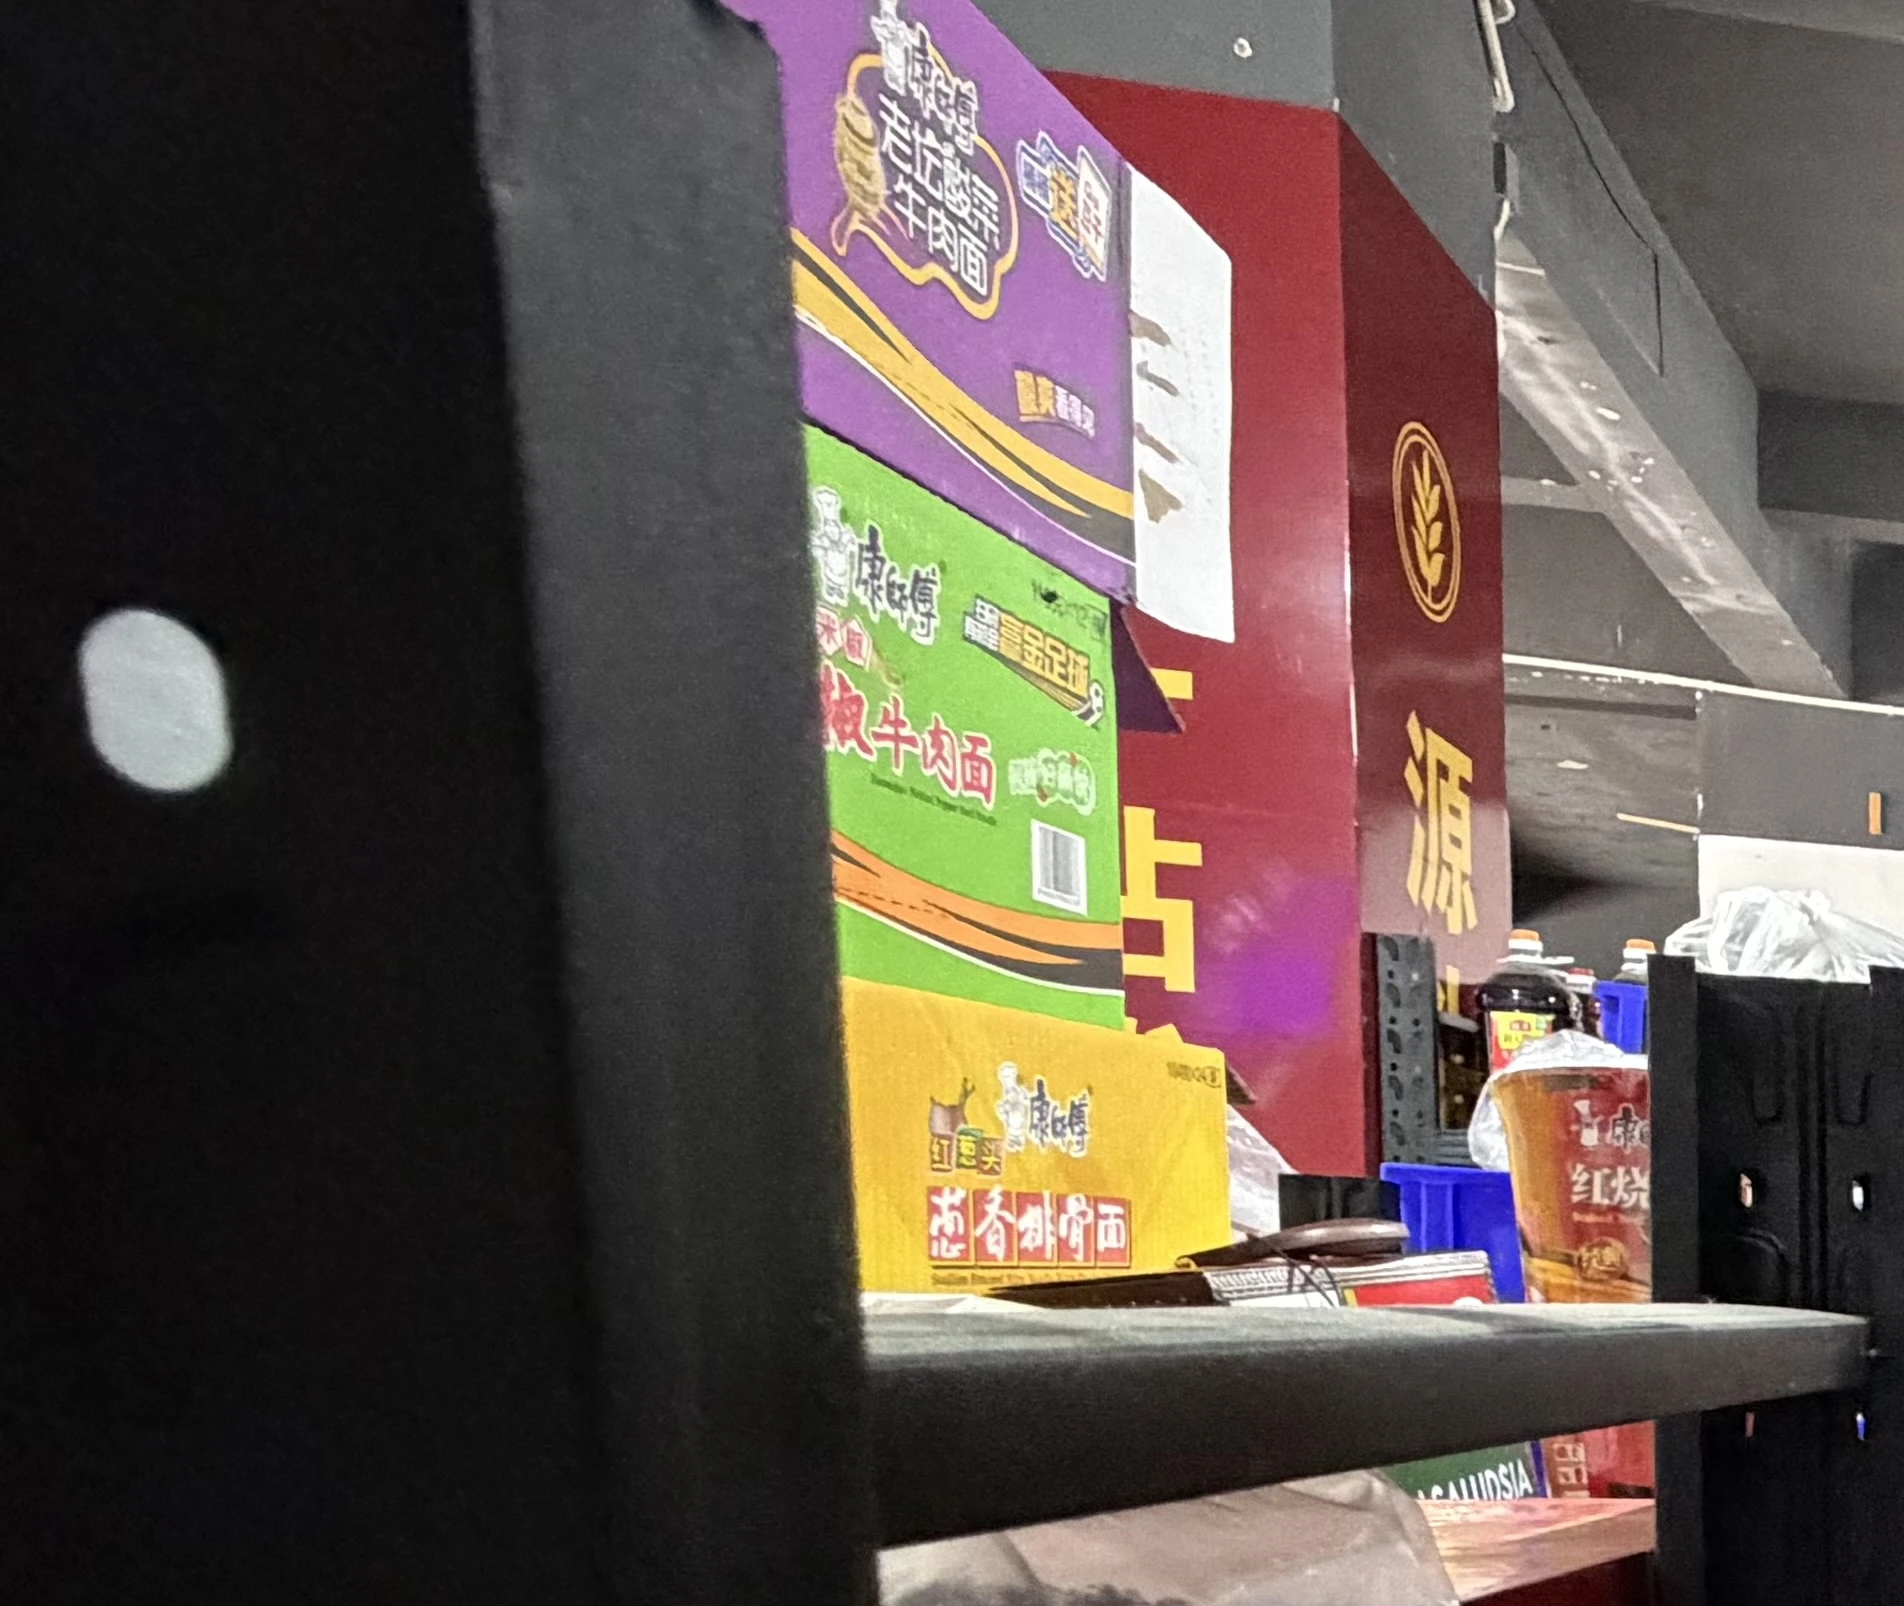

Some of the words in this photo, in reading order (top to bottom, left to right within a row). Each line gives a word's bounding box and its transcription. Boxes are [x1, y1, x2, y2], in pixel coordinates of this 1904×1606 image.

[894, 175, 988, 296] 牛肉面
[929, 1186, 1128, 1262] 葱香排骨面
